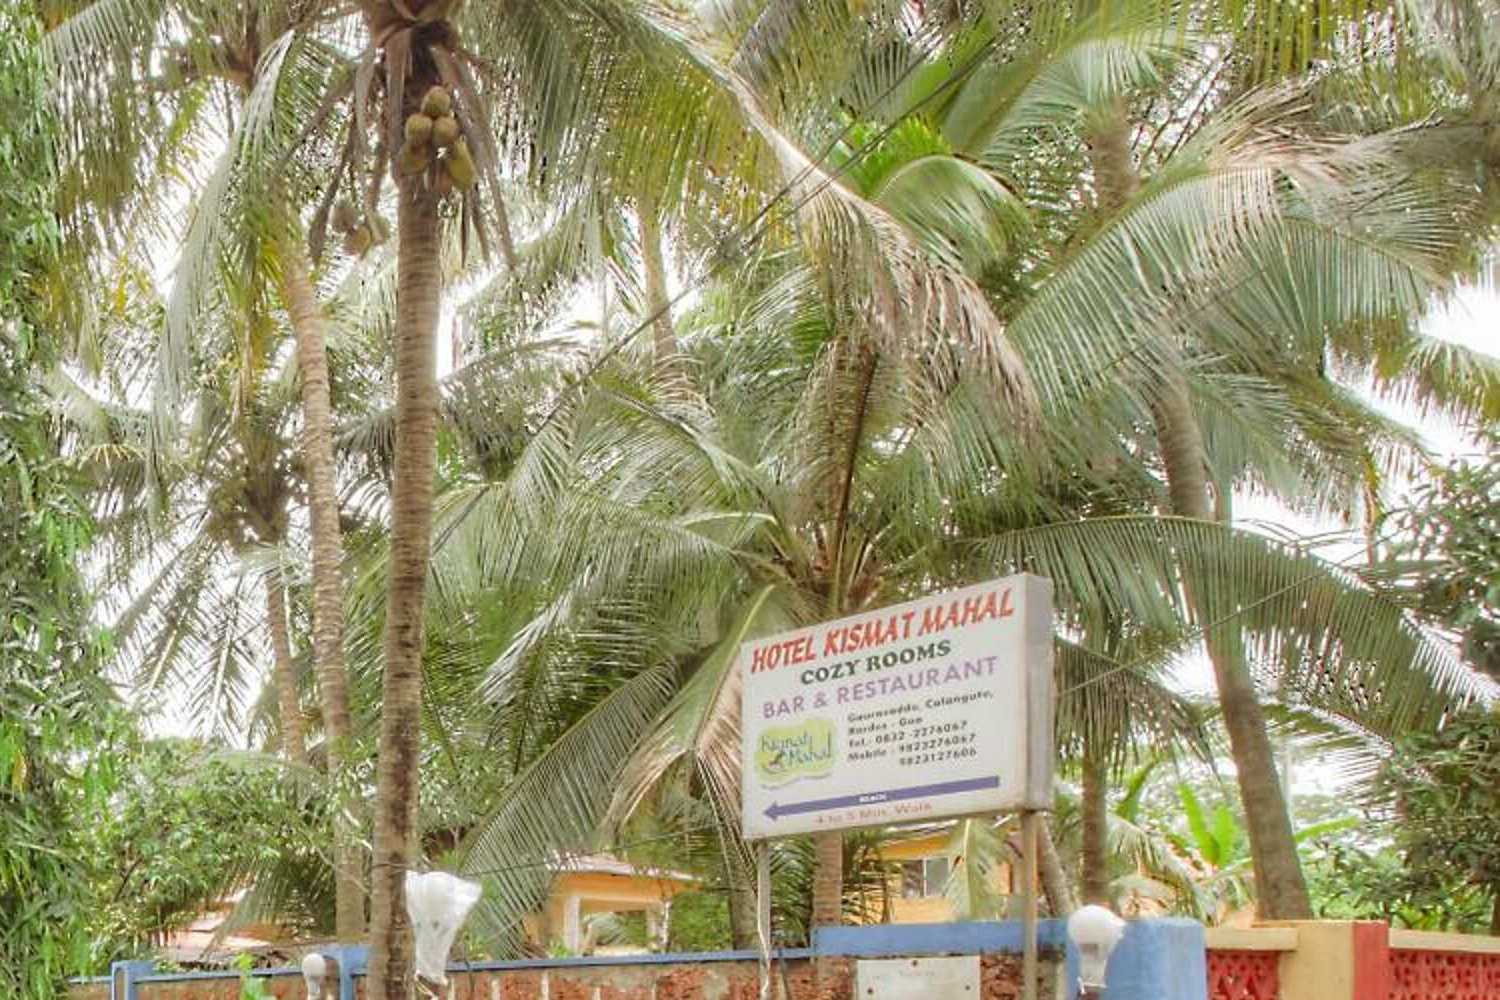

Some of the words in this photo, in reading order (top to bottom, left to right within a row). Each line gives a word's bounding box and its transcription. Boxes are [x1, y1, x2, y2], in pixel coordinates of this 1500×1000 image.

[751, 635, 817, 674] HOTEL
[823, 610, 916, 658] KISMAT
[917, 587, 1015, 637] MAHAL
[800, 660, 861, 685] COZY
[866, 639, 952, 672] ROOMS
[763, 695, 805, 719] BAR
[813, 691, 828, 709] &
[837, 655, 999, 705] RESTAURANT
